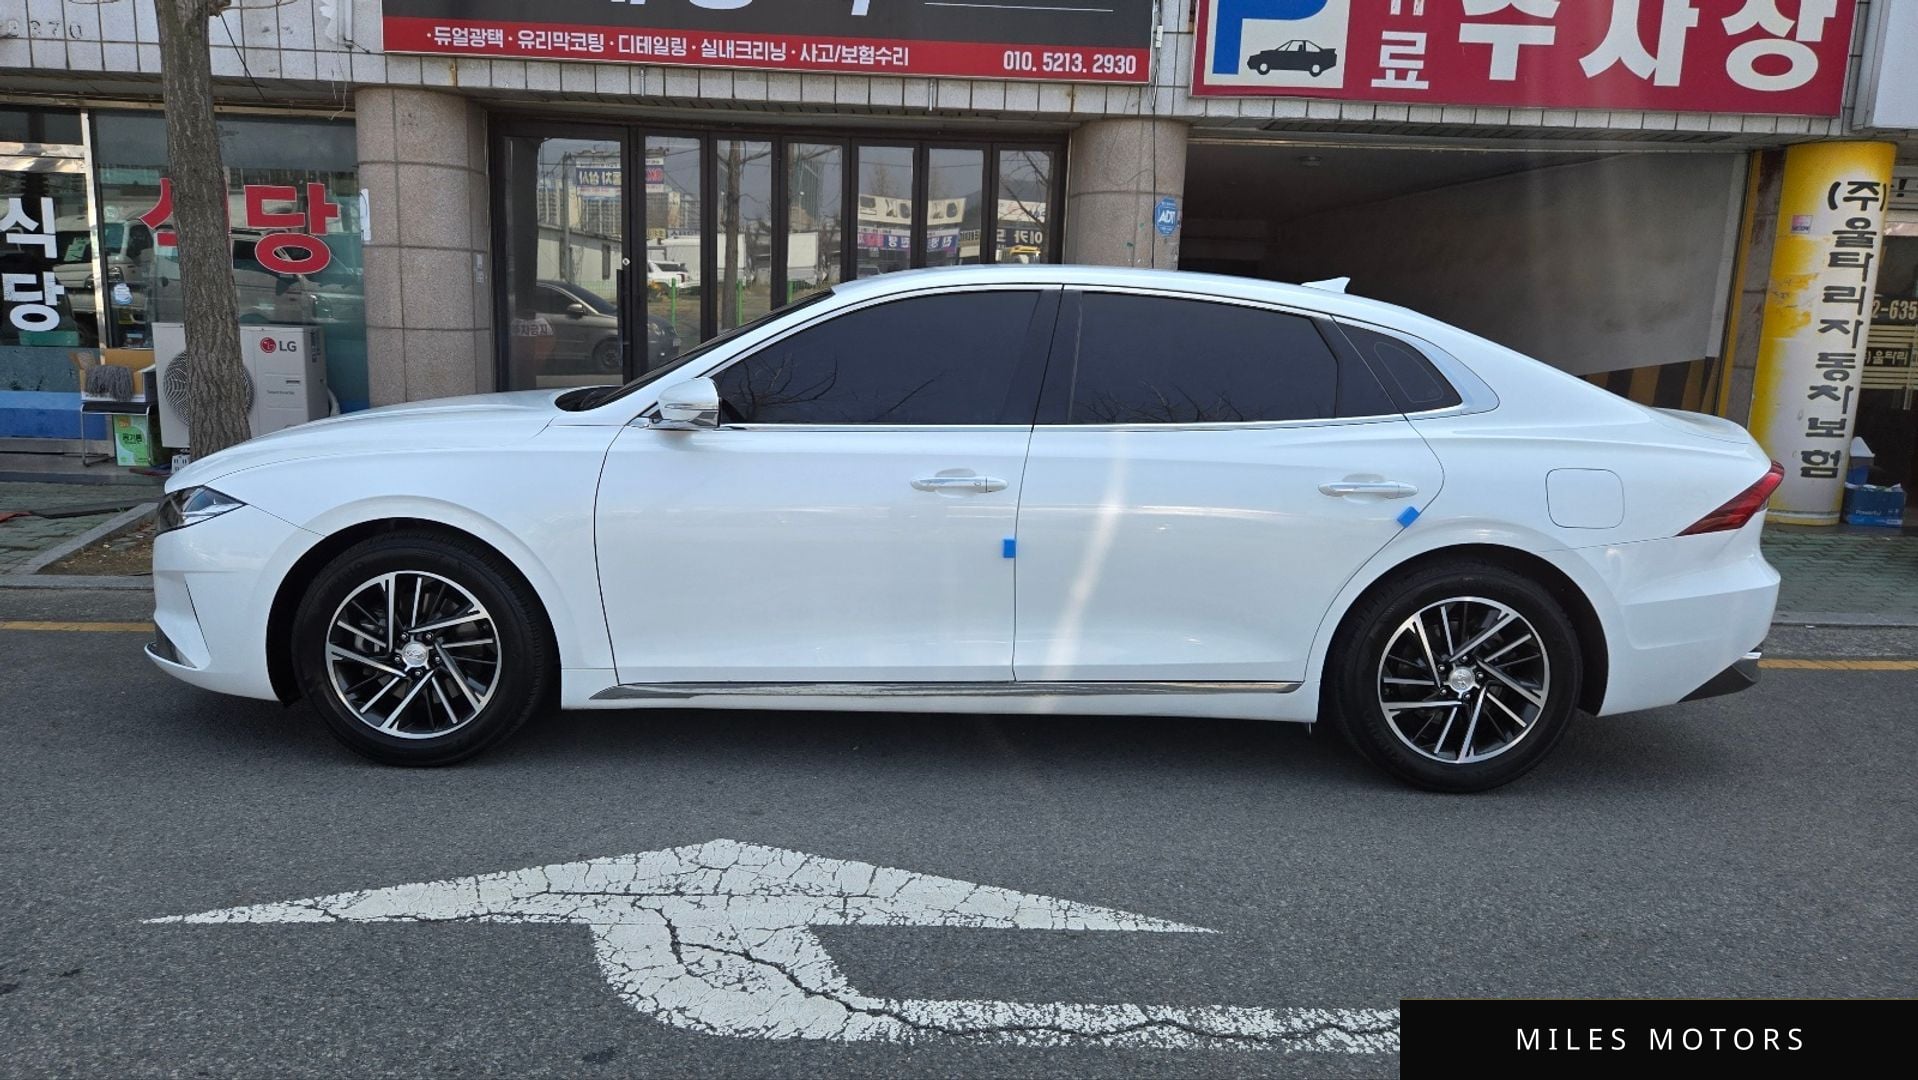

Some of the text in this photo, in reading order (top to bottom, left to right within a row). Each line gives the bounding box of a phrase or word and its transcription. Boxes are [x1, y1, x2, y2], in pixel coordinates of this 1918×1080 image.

[433, 26, 910, 67] 듀얼광택 유리막코팅 디테일링 실내크리닝 사고/보험수리
[1092, 54, 1137, 75] 2930
[1158, 209, 1176, 224] ADT
[0, 197, 65, 331] 식당
[279, 340, 297, 353] LG
